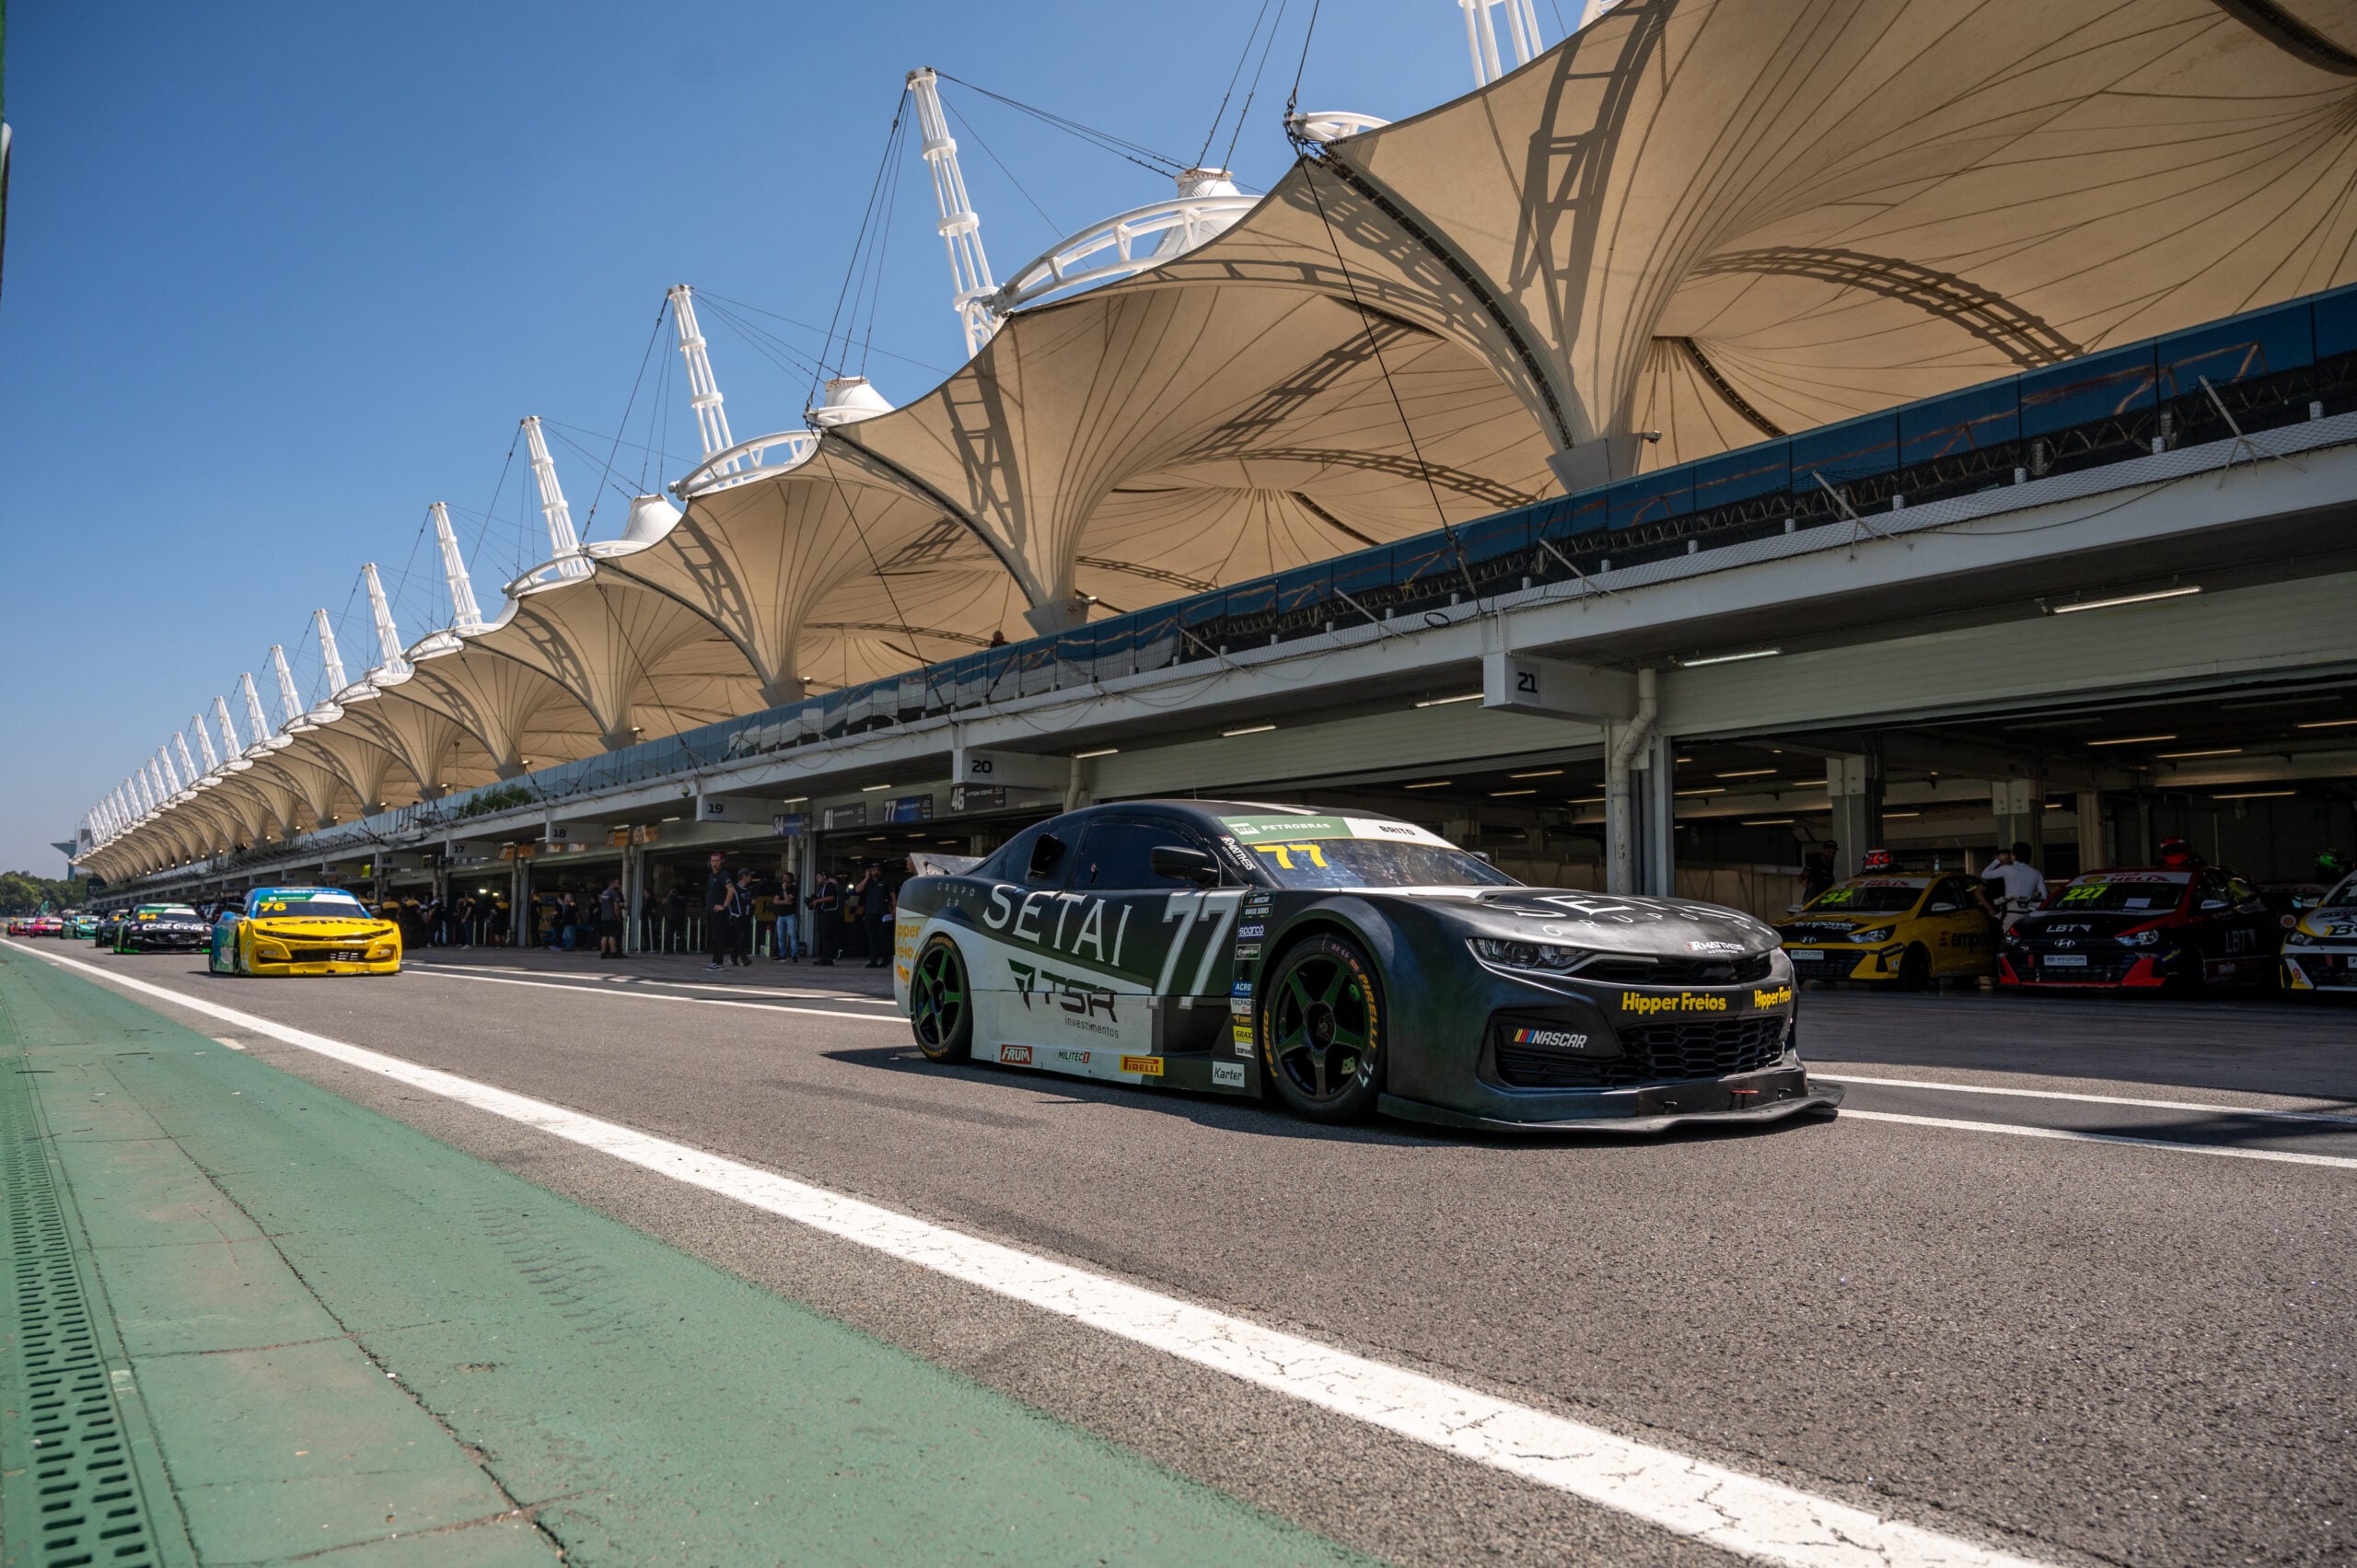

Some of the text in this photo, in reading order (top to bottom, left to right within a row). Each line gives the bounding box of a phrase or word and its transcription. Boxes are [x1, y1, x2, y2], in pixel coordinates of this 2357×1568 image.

[1517, 671, 1538, 693] 21
[971, 760, 993, 773] 20
[951, 787, 965, 811] 46
[708, 804, 724, 813] 19
[884, 800, 897, 822] 77
[552, 829, 566, 838] 18
[1260, 822, 1331, 832] PETROBRAS
[1378, 825, 1417, 836] BRITO
[453, 845, 465, 854] 17
[1253, 843, 1329, 869] 77
[936, 882, 975, 898] GRUPO
[1820, 889, 1854, 904] 32
[260, 902, 287, 912] 76
[946, 898, 959, 908] GP
[981, 884, 1133, 968] SETAI
[1238, 924, 1265, 935] sparco
[1542, 912, 1700, 936] GRUPO
[2046, 923, 2078, 934] LBT
[2224, 928, 2247, 954] LBT
[1146, 889, 1248, 1010] 77
[1235, 982, 1252, 991] ACRO
[1040, 970, 1118, 1023] TSR
[1621, 992, 1727, 1015] Hipper Freios
[1754, 986, 1792, 1010] Hipper Frei
[1358, 973, 1378, 1050] PIRELLI
[1064, 1015, 1120, 1039] investimentos
[1236, 1030, 1252, 1039] GRAX
[1532, 1030, 1587, 1049] NASCAR
[1002, 1046, 1030, 1062] FRUM
[1123, 1056, 1159, 1074] PIRELLI
[1213, 1067, 1243, 1081] Karter
